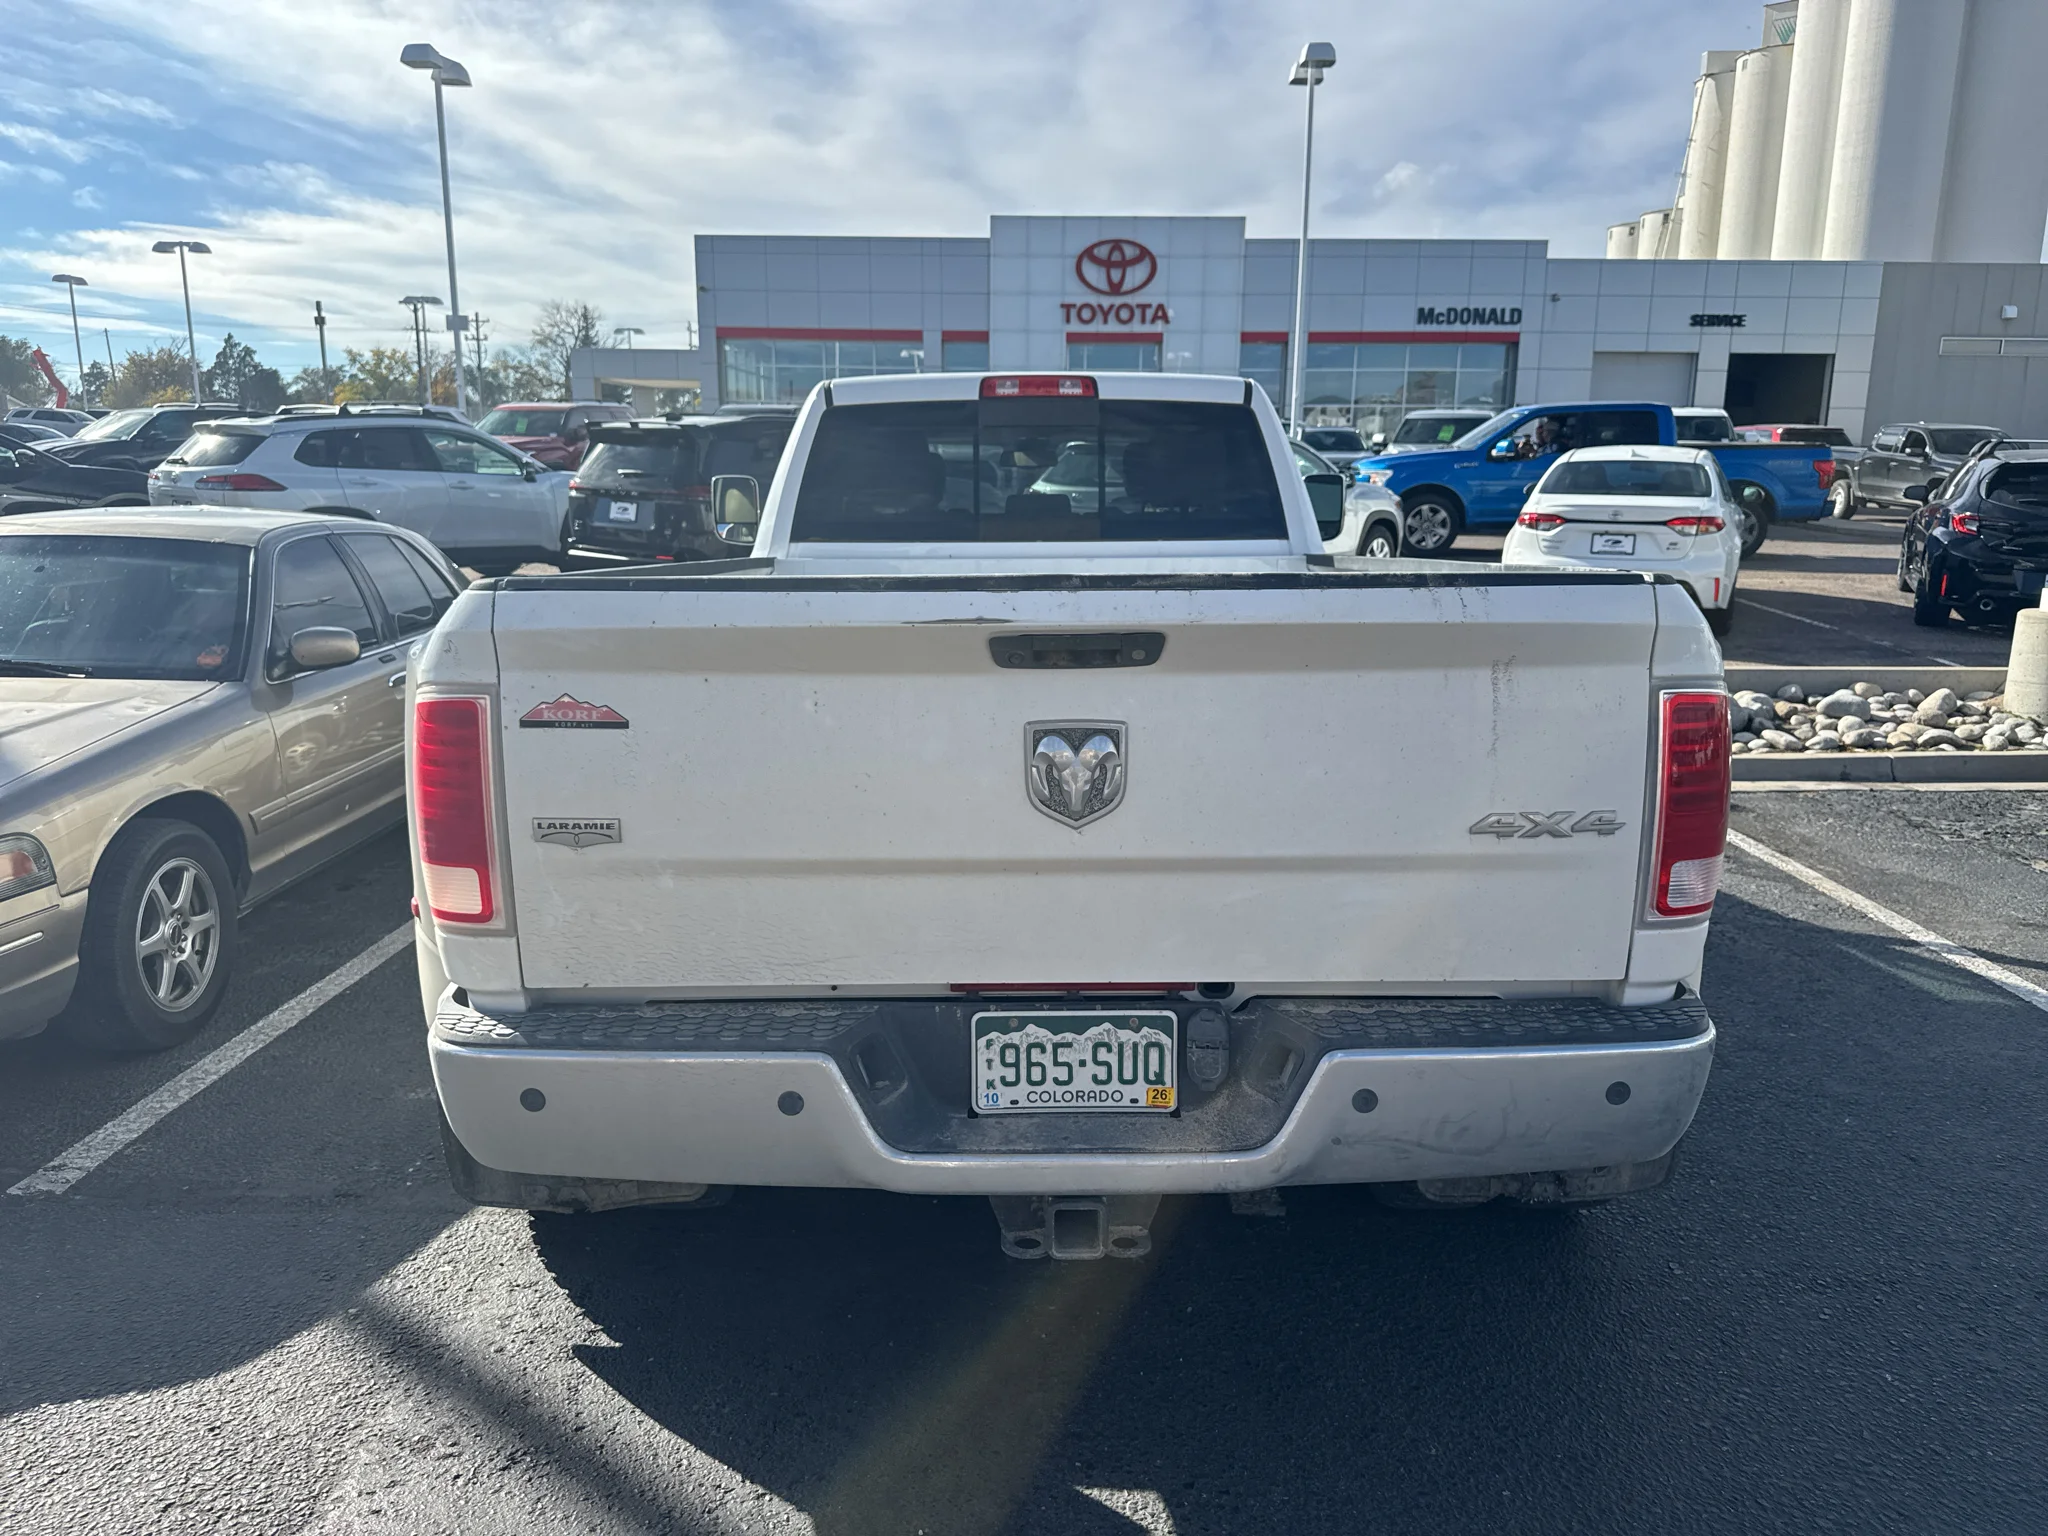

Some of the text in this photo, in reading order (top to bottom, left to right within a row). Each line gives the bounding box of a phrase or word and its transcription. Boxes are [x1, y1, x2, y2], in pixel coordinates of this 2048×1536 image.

[1060, 303, 1170, 325] TOYOTA
[1417, 307, 1522, 326] McDONALD
[1689, 313, 1747, 328] SERVICE
[542, 709, 603, 720] KORF
[537, 822, 616, 831] LARAMIE
[983, 1092, 999, 1104] 10
[1027, 1089, 1124, 1103] COLORADO
[1151, 1088, 1168, 1101] 26
